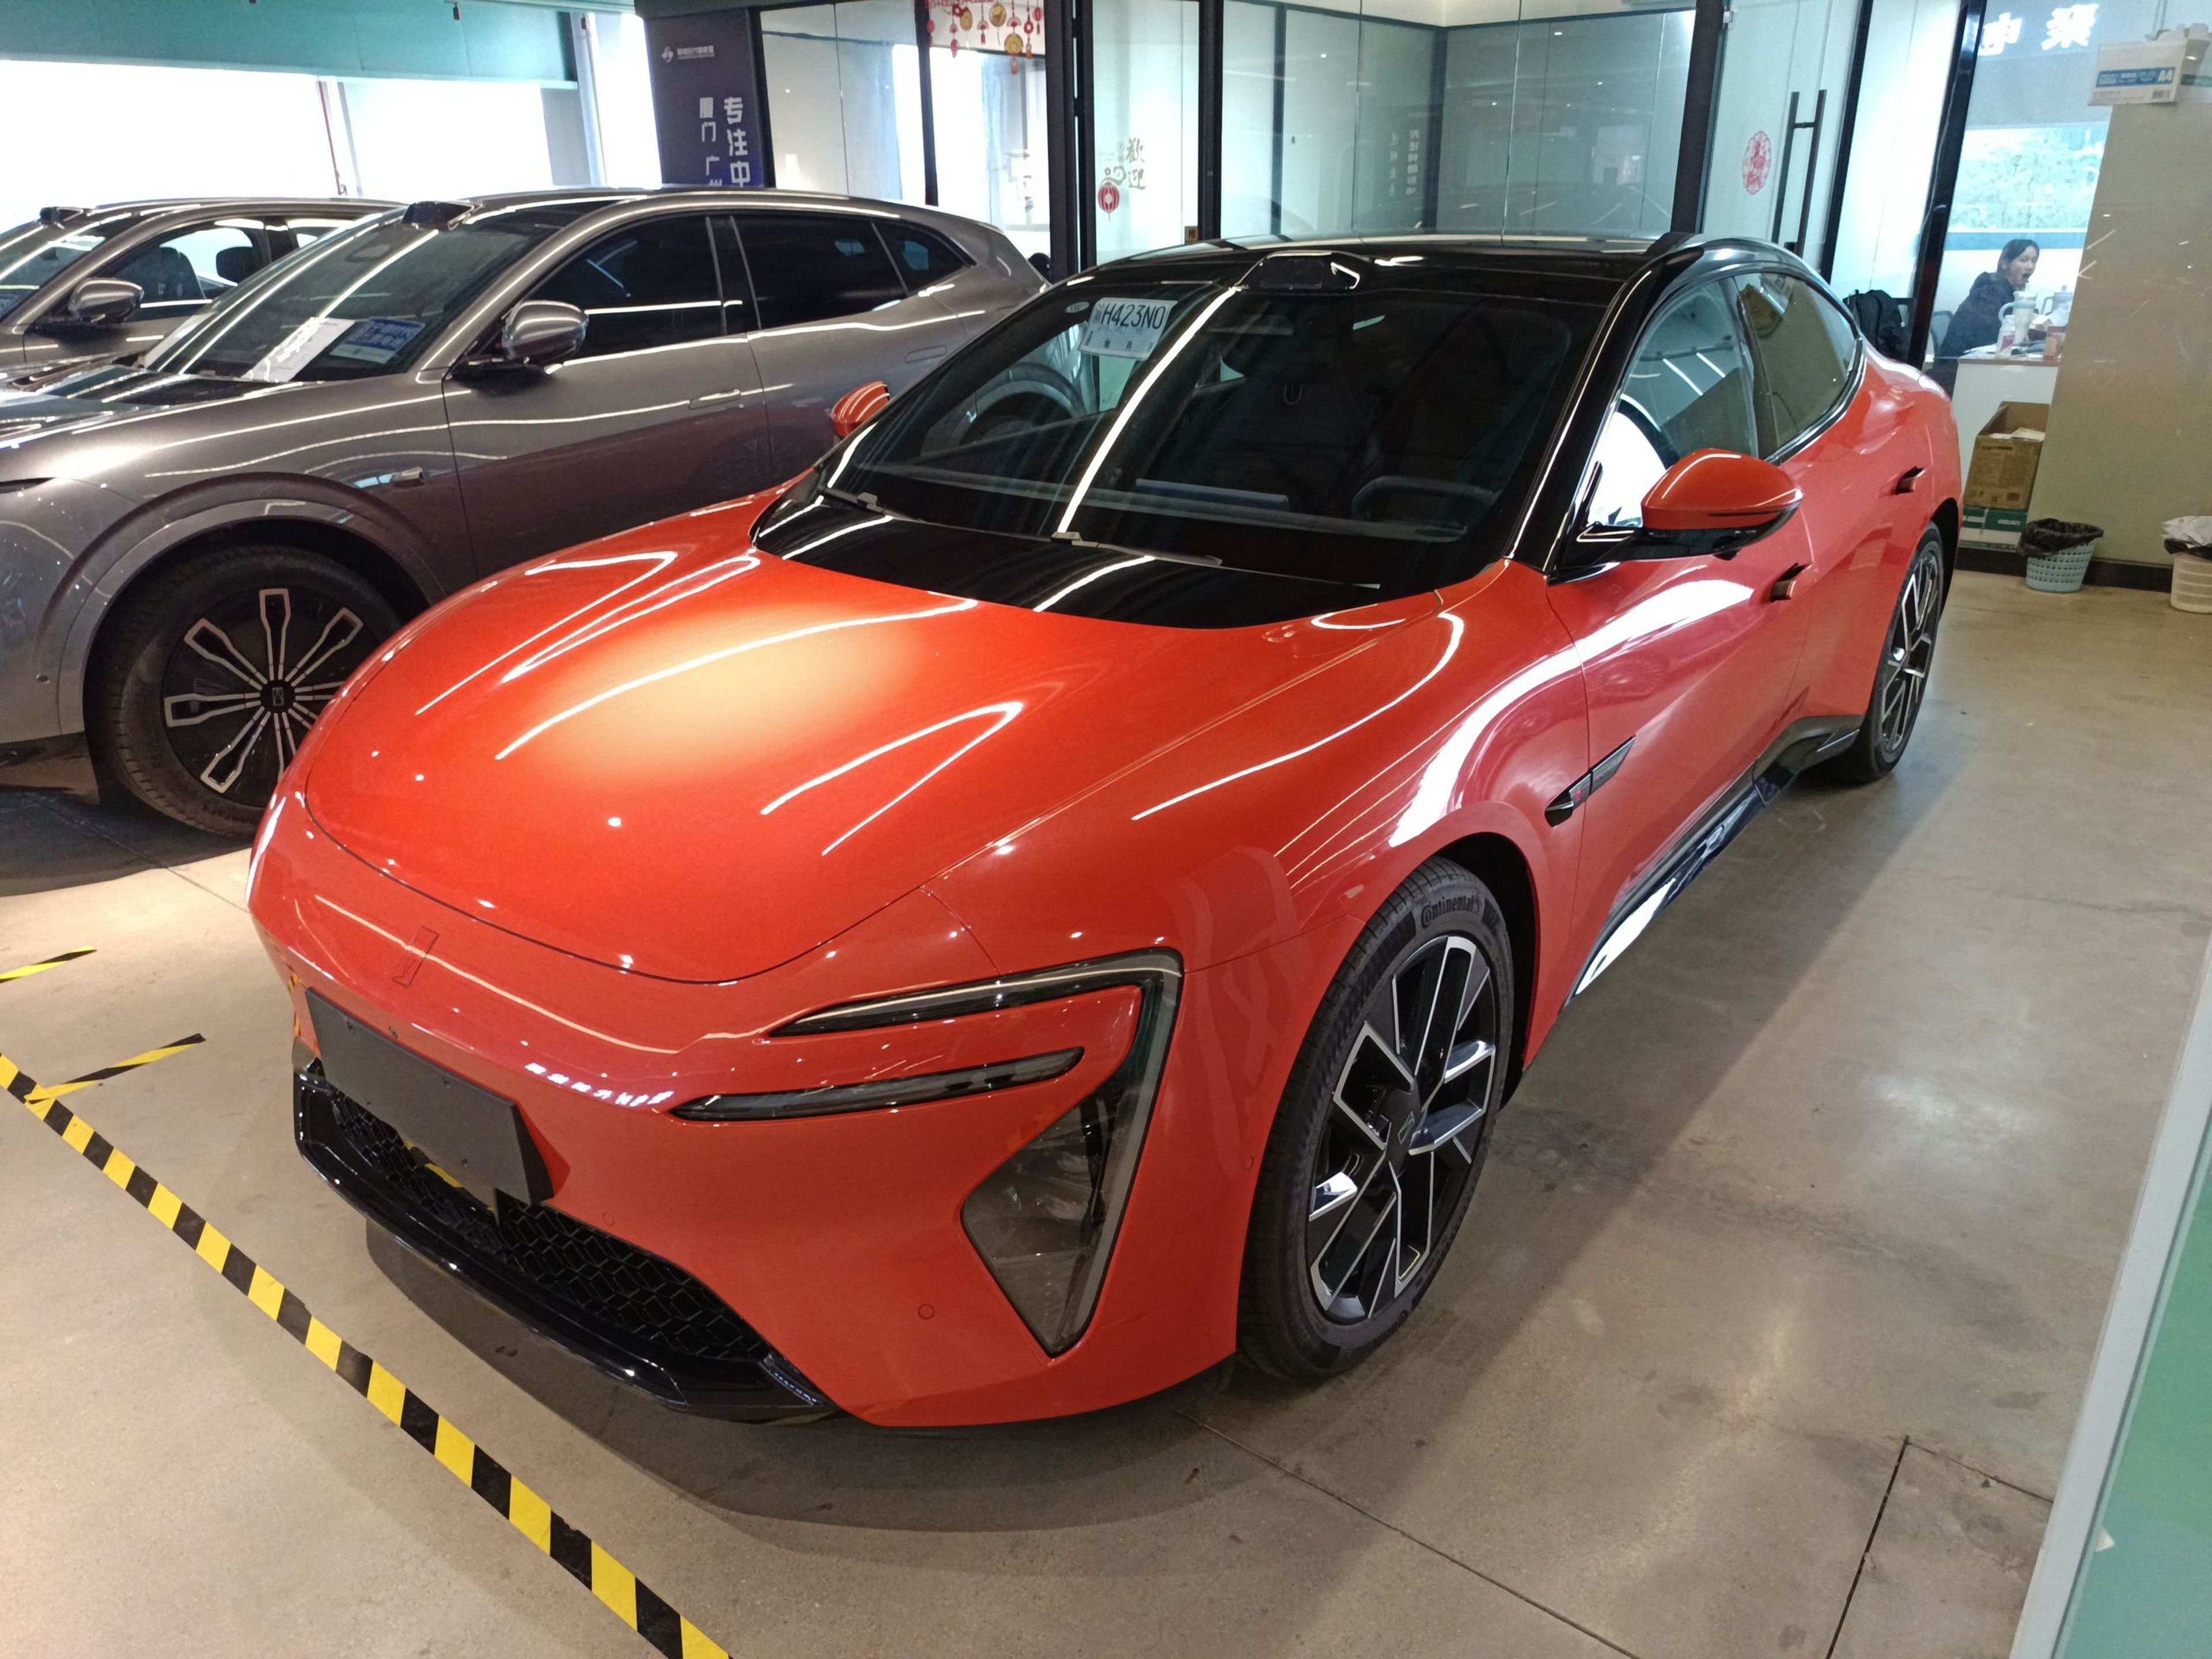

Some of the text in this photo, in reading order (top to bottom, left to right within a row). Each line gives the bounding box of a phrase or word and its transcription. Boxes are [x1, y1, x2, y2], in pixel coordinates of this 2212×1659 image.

[2158, 70, 2173, 82] A4
[724, 97, 751, 187] 专注中
[1421, 895, 1474, 929] Continental
